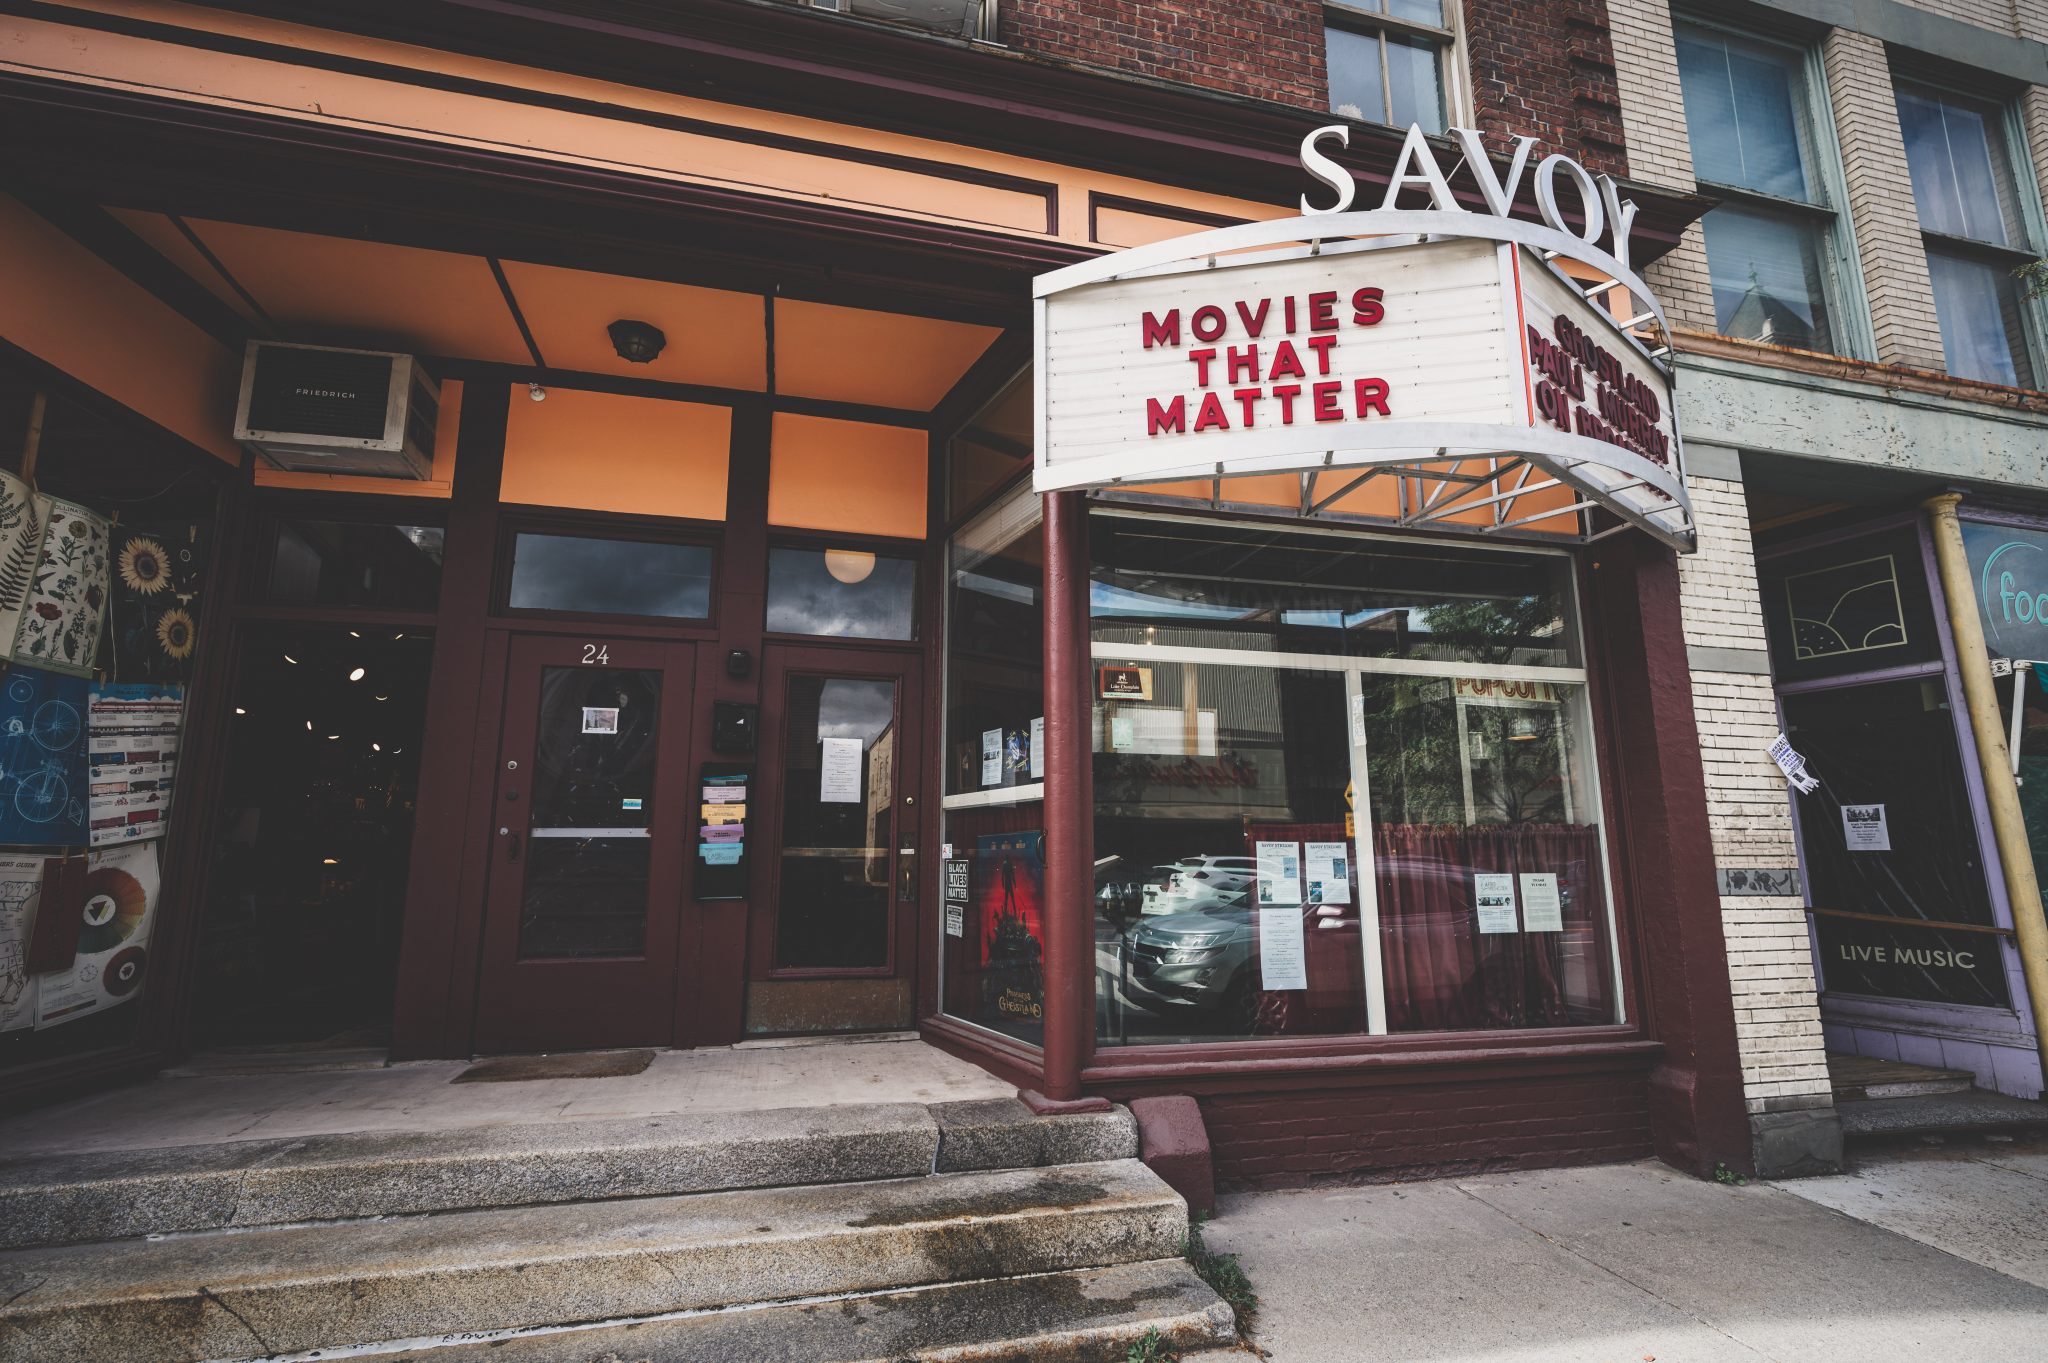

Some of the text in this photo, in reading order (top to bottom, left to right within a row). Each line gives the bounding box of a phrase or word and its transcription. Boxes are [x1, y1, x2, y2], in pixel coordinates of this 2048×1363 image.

[1301, 122, 1639, 267] SAVOY
[1141, 287, 1385, 349] MOVIES
[1188, 334, 1338, 388] THAT
[1554, 314, 1661, 424] GHOSTLAND
[295, 388, 356, 399] FRIEDRICH
[1146, 377, 1392, 436] MATTER
[1527, 323, 1585, 402] PAULI
[1597, 382, 1669, 465] MURRAY
[1535, 380, 1571, 434] ON
[581, 644, 610, 665] 24
[948, 863, 967, 873] BLACK
[948, 874, 967, 886] LIVES
[947, 887, 967, 899] MATTER
[1840, 943, 1976, 970] LIVE MUSIC
[998, 996, 1042, 1018] GHOSTLAND
